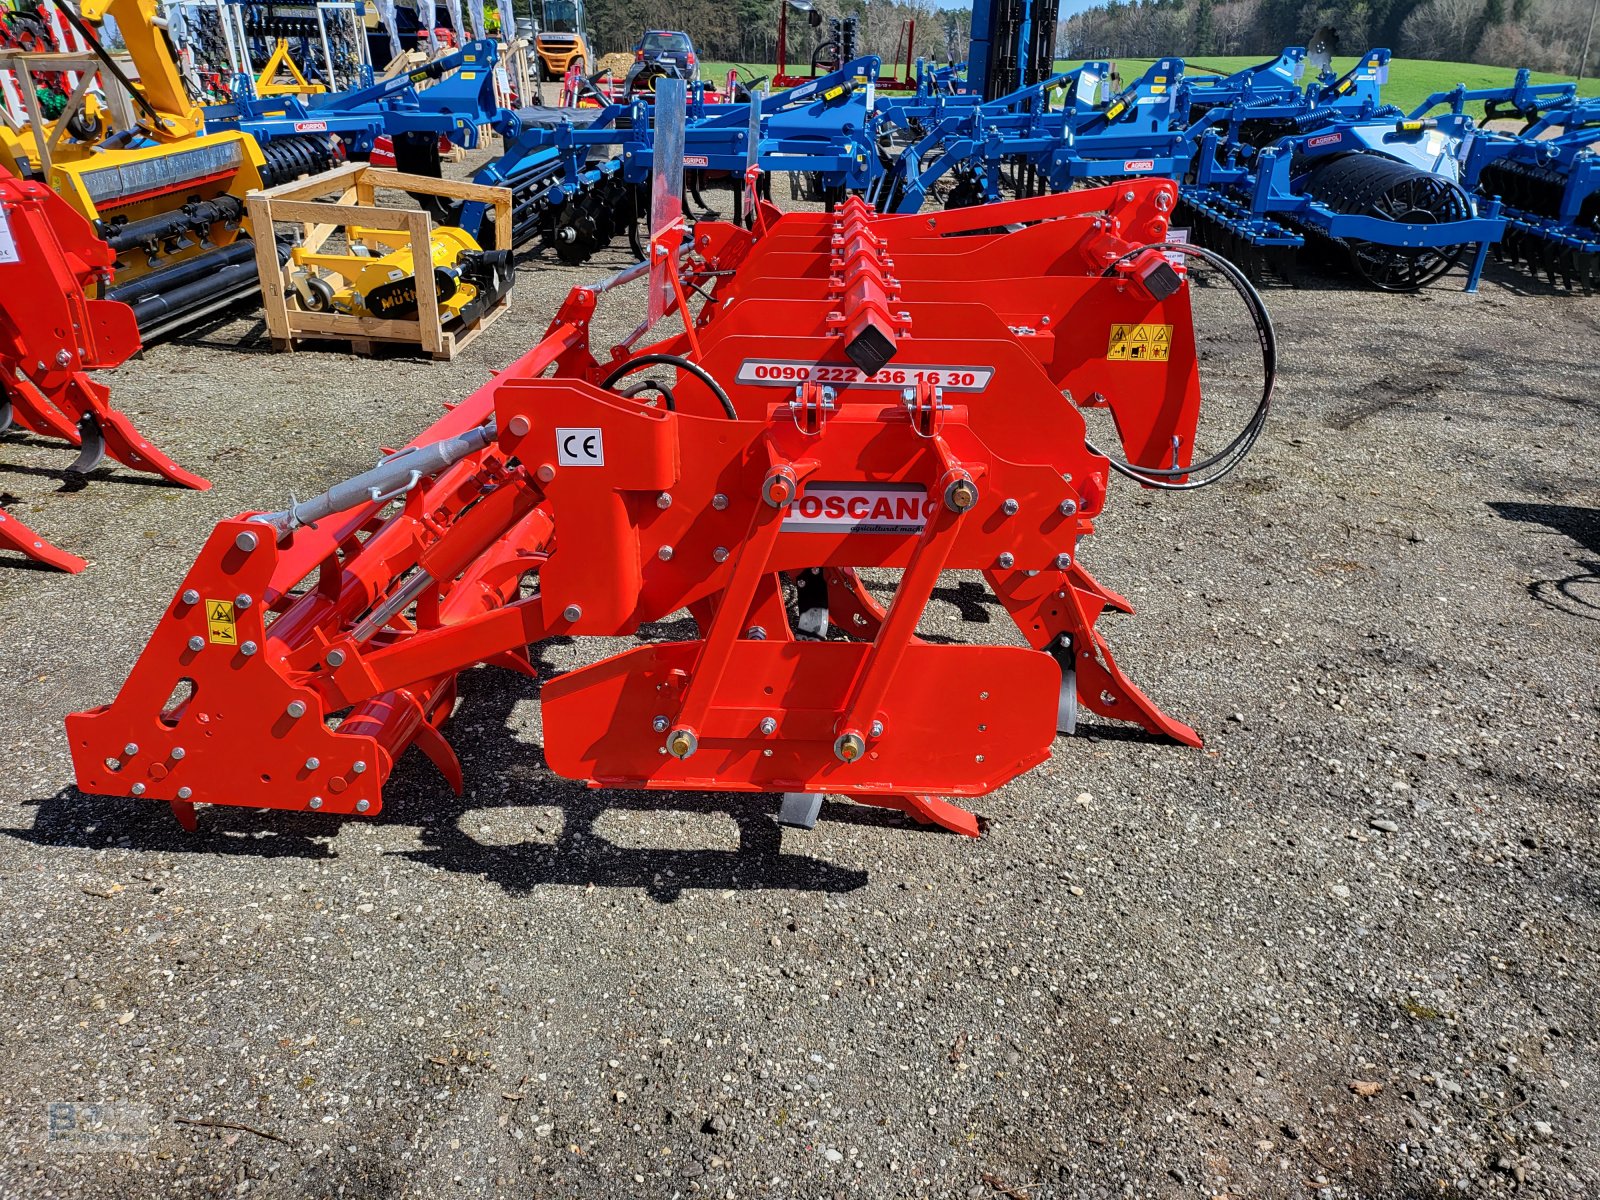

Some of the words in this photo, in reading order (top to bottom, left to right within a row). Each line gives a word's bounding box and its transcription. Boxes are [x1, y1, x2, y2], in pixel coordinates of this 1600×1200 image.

[755, 365, 810, 380] 0090
[816, 368, 858, 382] 222
[914, 371, 941, 385] 16
[947, 372, 975, 386] 30
[563, 435, 598, 459] CE
